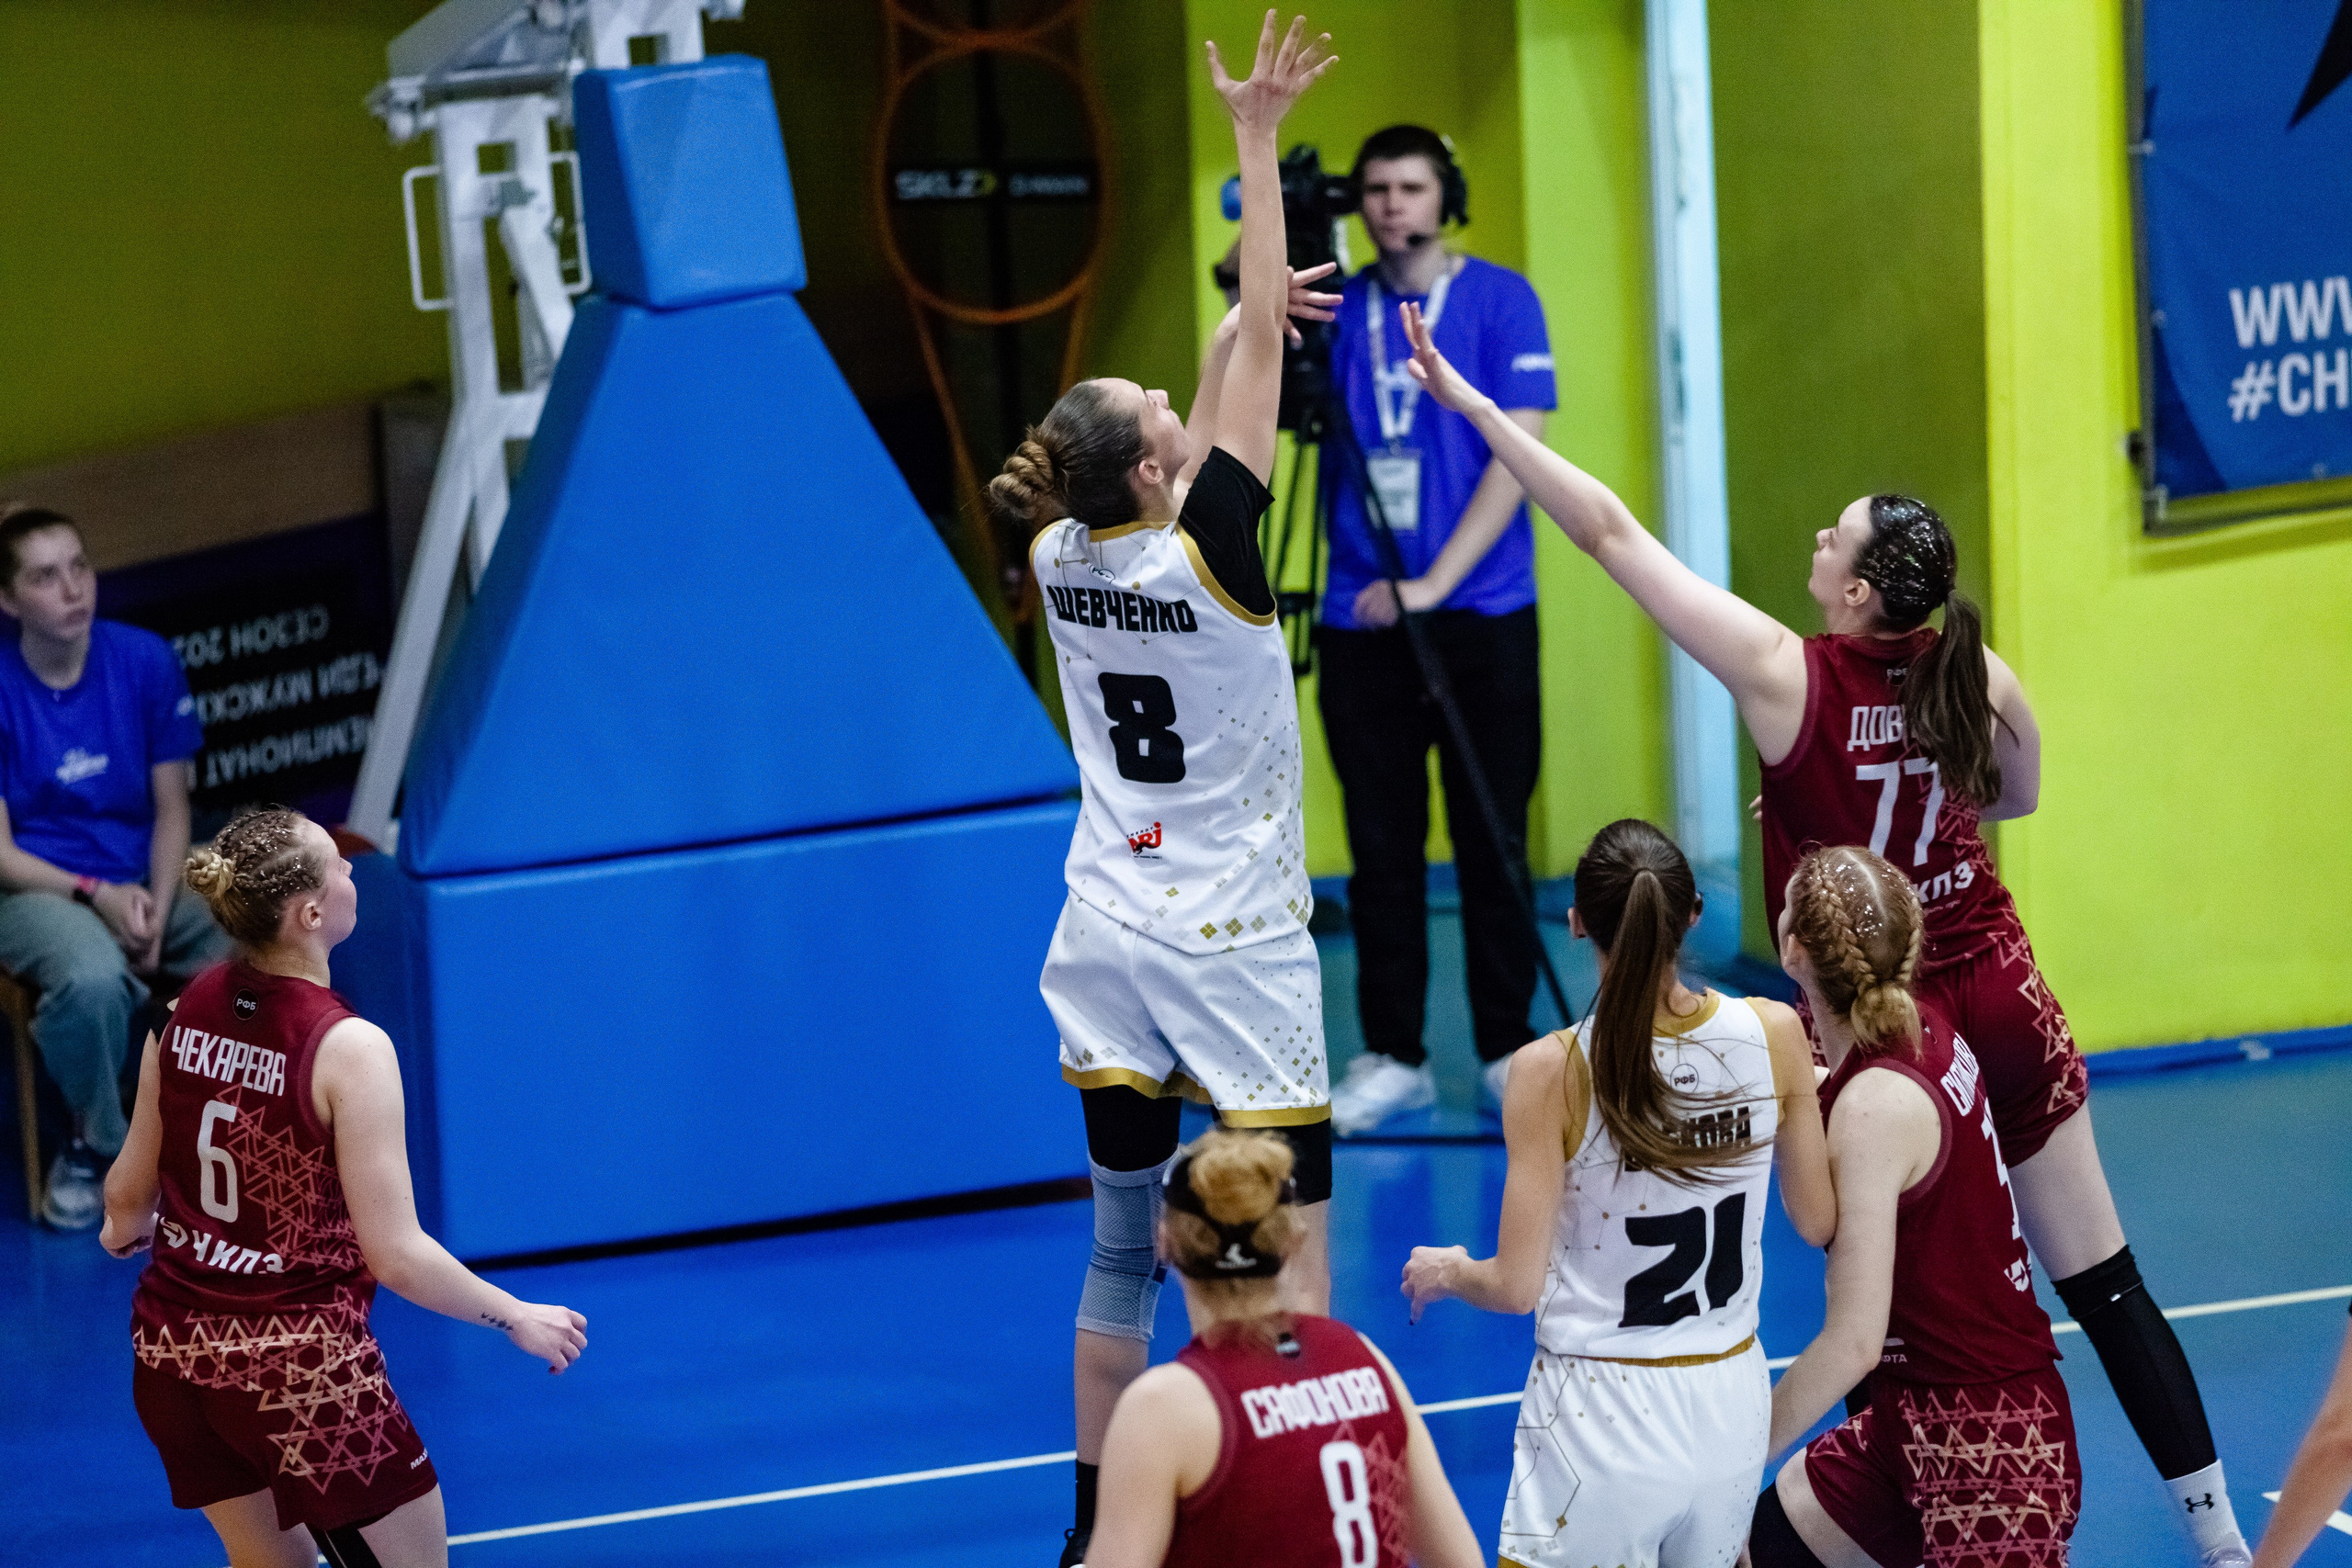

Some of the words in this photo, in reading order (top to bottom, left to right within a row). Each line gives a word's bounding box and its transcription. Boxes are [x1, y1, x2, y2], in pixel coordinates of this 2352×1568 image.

[2227, 347, 2352, 423] #CH
[229, 603, 329, 660] СЕЗОН
[1046, 584, 1198, 634] ШЕВЧЕНКО
[195, 668, 313, 726] МУЖСКИ
[1098, 672, 1186, 784] 8
[1847, 705, 1905, 751] ДОВ
[203, 715, 372, 788] ЕМПИОНАТ
[1856, 757, 1945, 867] 77
[1912, 861, 1975, 904] КПЗ
[236, 998, 257, 1010] РФБ
[171, 1025, 287, 1097] ЧЕКАРЕВА
[1674, 1074, 1696, 1087] РФБ
[197, 1100, 239, 1224] 6
[1618, 1191, 1747, 1328] 21
[1240, 1366, 1390, 1439] САФОНОВА
[1319, 1439, 1378, 1568] 8
